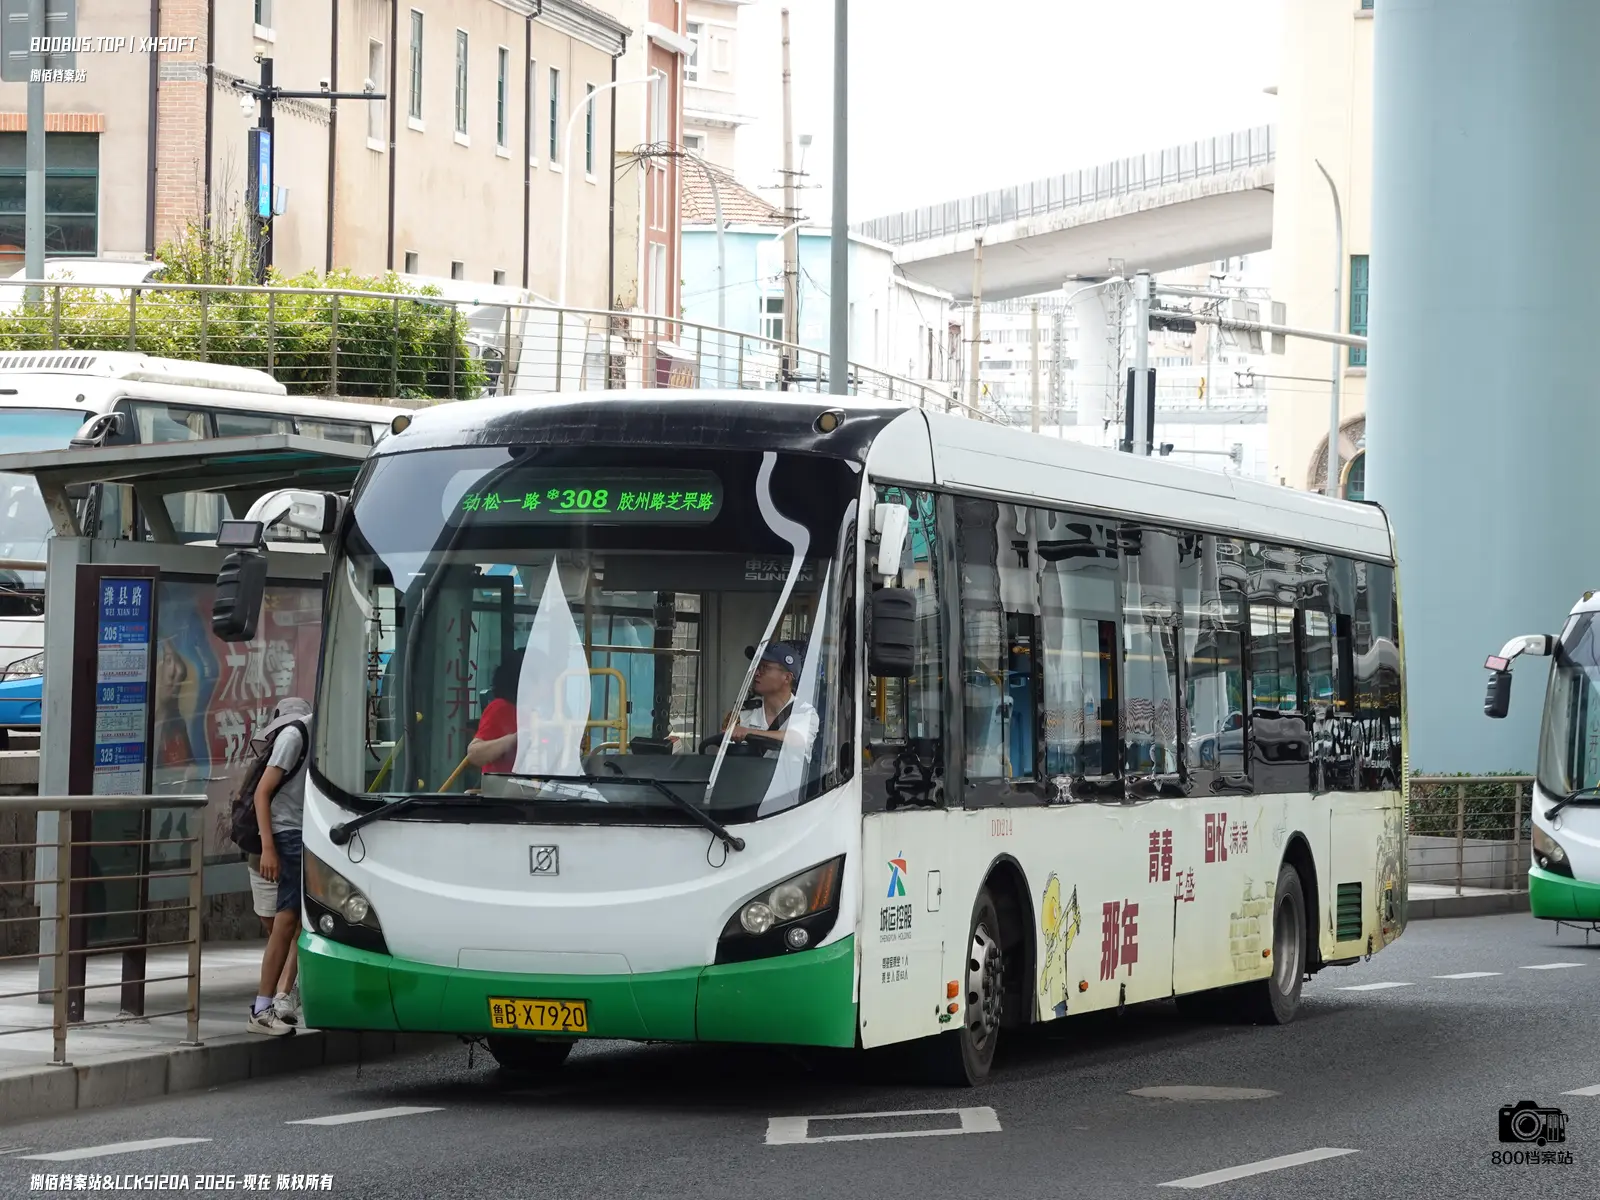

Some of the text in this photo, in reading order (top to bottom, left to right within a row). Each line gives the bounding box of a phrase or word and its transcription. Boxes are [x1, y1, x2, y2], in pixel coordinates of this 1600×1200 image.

[462, 489, 714, 512] 劲松一路 308 胶州路芝罘路
[104, 586, 142, 606] 潍县路
[105, 608, 140, 616] WEI XIAN LU
[104, 626, 117, 641] 205
[102, 687, 115, 702] 308
[101, 748, 114, 763] 325
[880, 904, 912, 932] 城运控股
[1100, 899, 1139, 981] 那年
